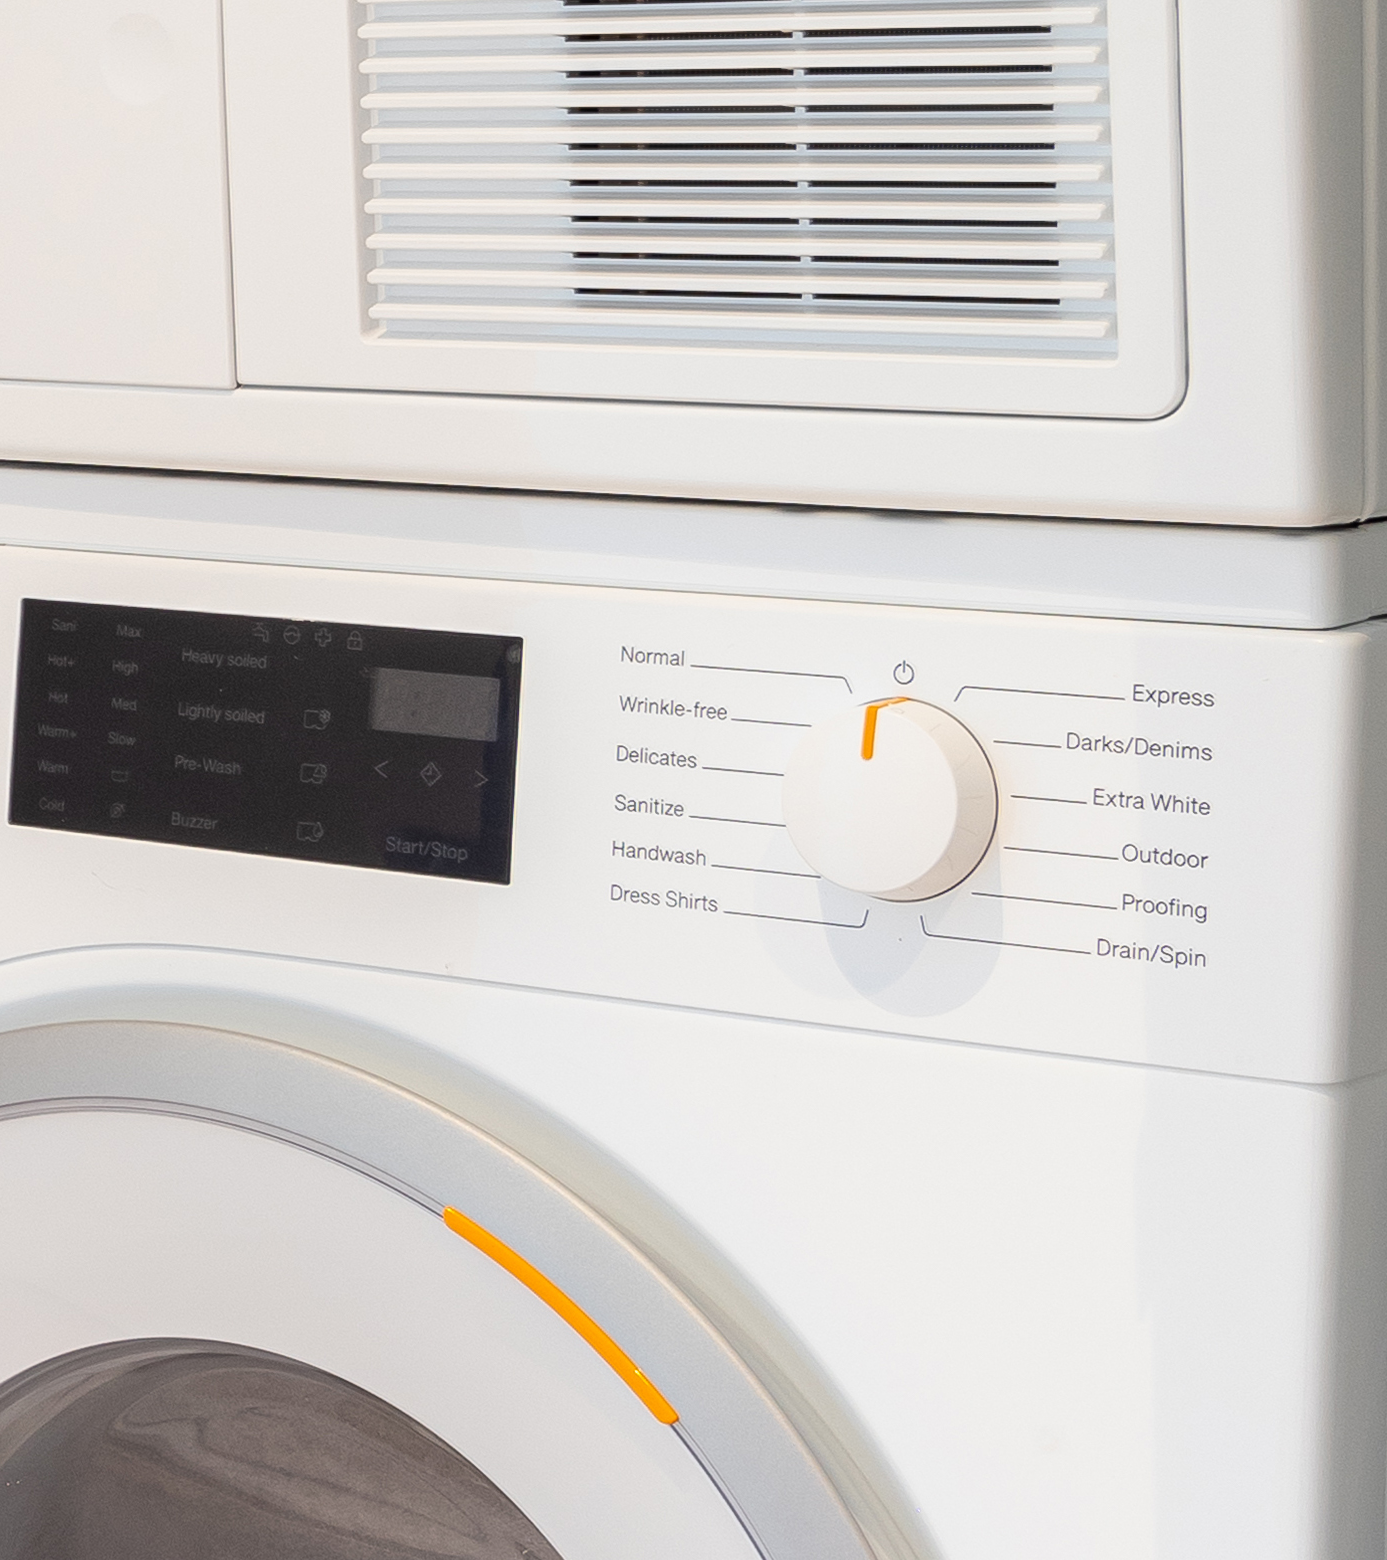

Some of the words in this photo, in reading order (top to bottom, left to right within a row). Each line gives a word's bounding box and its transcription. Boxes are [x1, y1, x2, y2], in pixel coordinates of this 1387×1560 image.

[51, 618, 76, 633] Sani
[116, 624, 142, 639] Max
[47, 655, 75, 668] Hot+
[112, 660, 139, 676] High
[181, 648, 223, 669] Heavy
[227, 654, 267, 669] soiled
[620, 646, 685, 668] Normal
[49, 691, 69, 704] Hot
[111, 697, 137, 712] Med
[1132, 684, 1215, 709] Express
[178, 702, 221, 723] Lightly
[225, 708, 265, 724] soiled
[619, 696, 728, 721] Wrinkle-free
[37, 723, 77, 739] Warm+
[108, 731, 136, 747] Slow
[616, 745, 698, 769] Delicates
[1066, 732, 1213, 762] Darks/Denims
[37, 760, 69, 775] Warm
[174, 754, 241, 776] Pre-Wash
[39, 797, 65, 812] Cold
[614, 795, 685, 818] Sanitize
[1092, 789, 1146, 812] Extra
[1150, 792, 1211, 816] White
[171, 811, 218, 830] Buzzer
[385, 835, 469, 862] Start/Stop
[611, 841, 706, 867] Handwash
[1122, 844, 1208, 869] Outdoor
[610, 884, 661, 908] Dress
[664, 889, 718, 913] Shirts
[1121, 894, 1208, 924] Proofing
[1096, 938, 1207, 969] Drain/Spin
